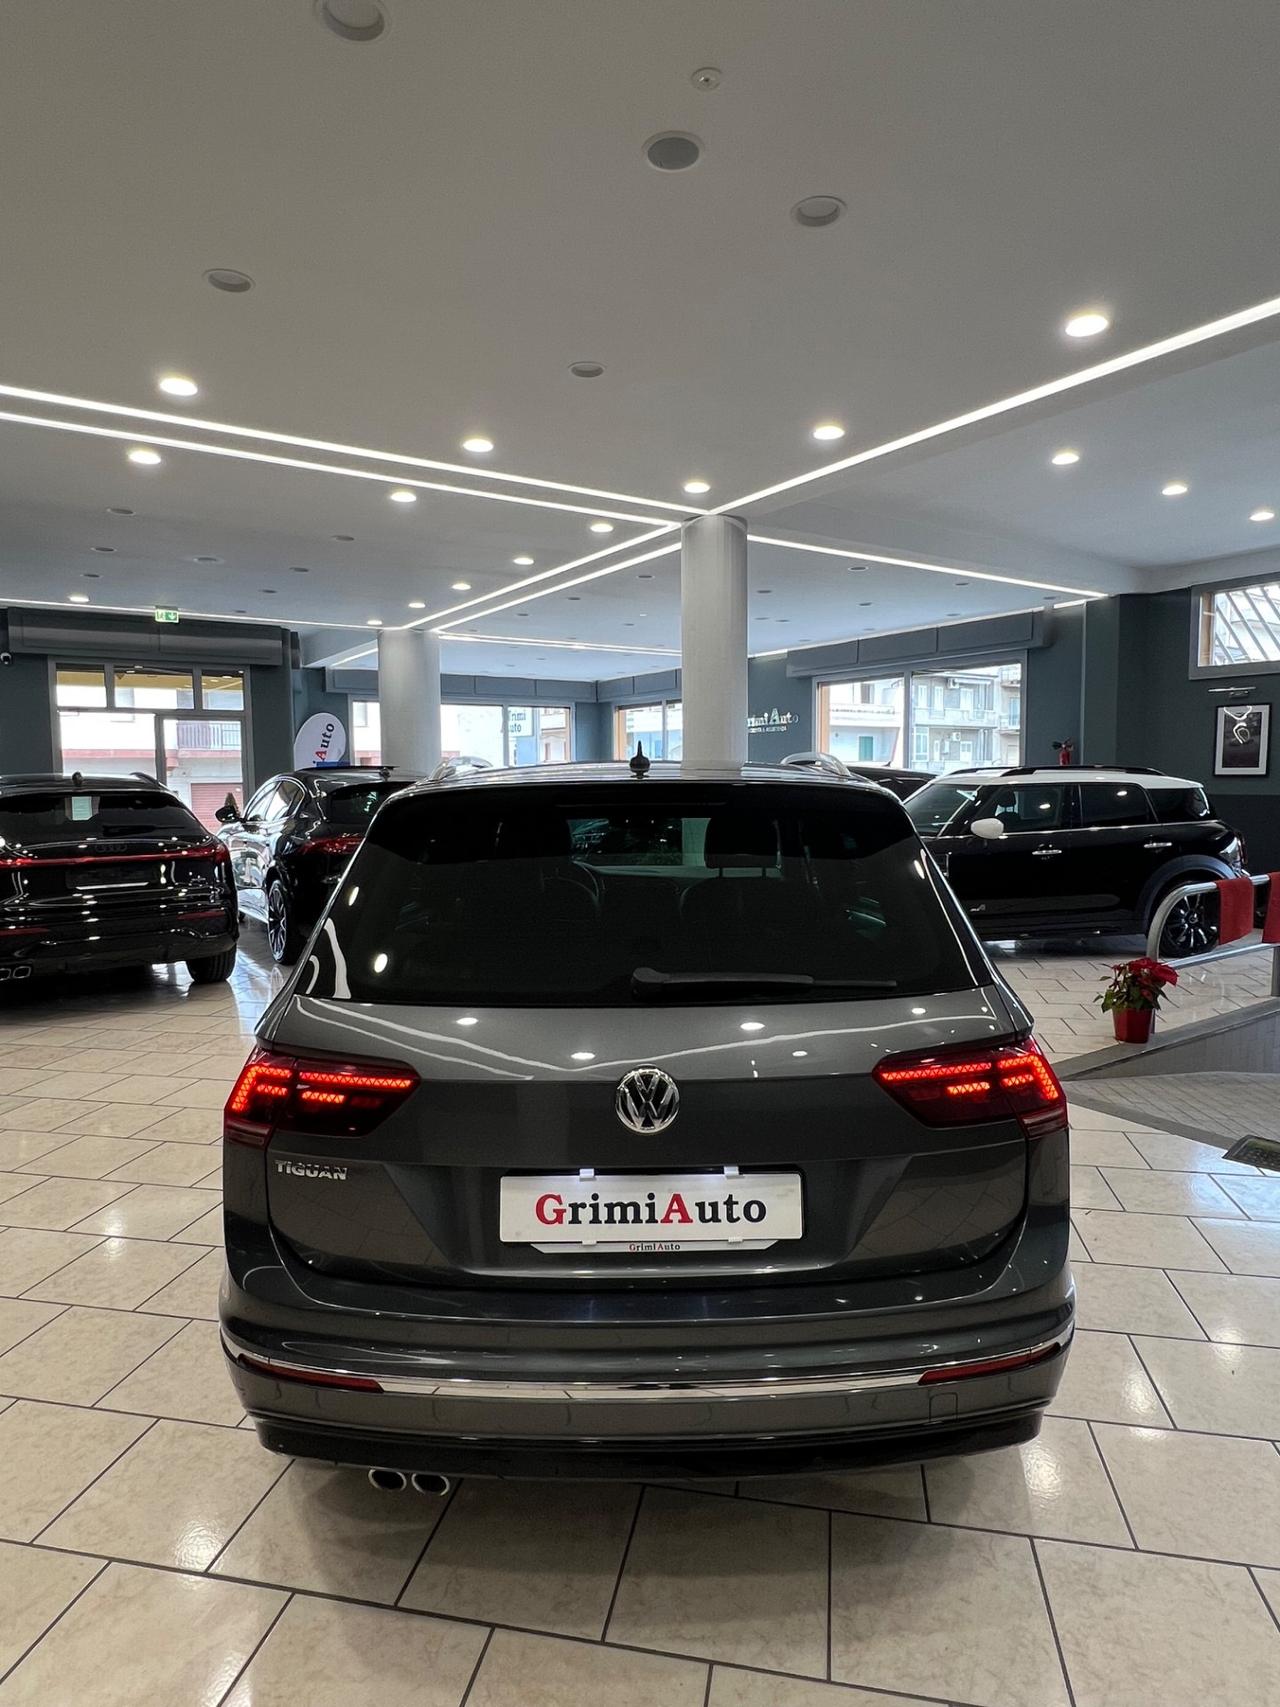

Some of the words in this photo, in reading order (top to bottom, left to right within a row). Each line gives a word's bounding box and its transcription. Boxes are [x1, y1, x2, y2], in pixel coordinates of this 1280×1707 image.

[747, 708, 799, 727] rimiAuto
[313, 723, 335, 762] Auto
[275, 1159, 348, 1181] TIGUAN
[535, 1192, 767, 1225] GrimiAuto
[629, 1242, 681, 1252] GrimiAuto
